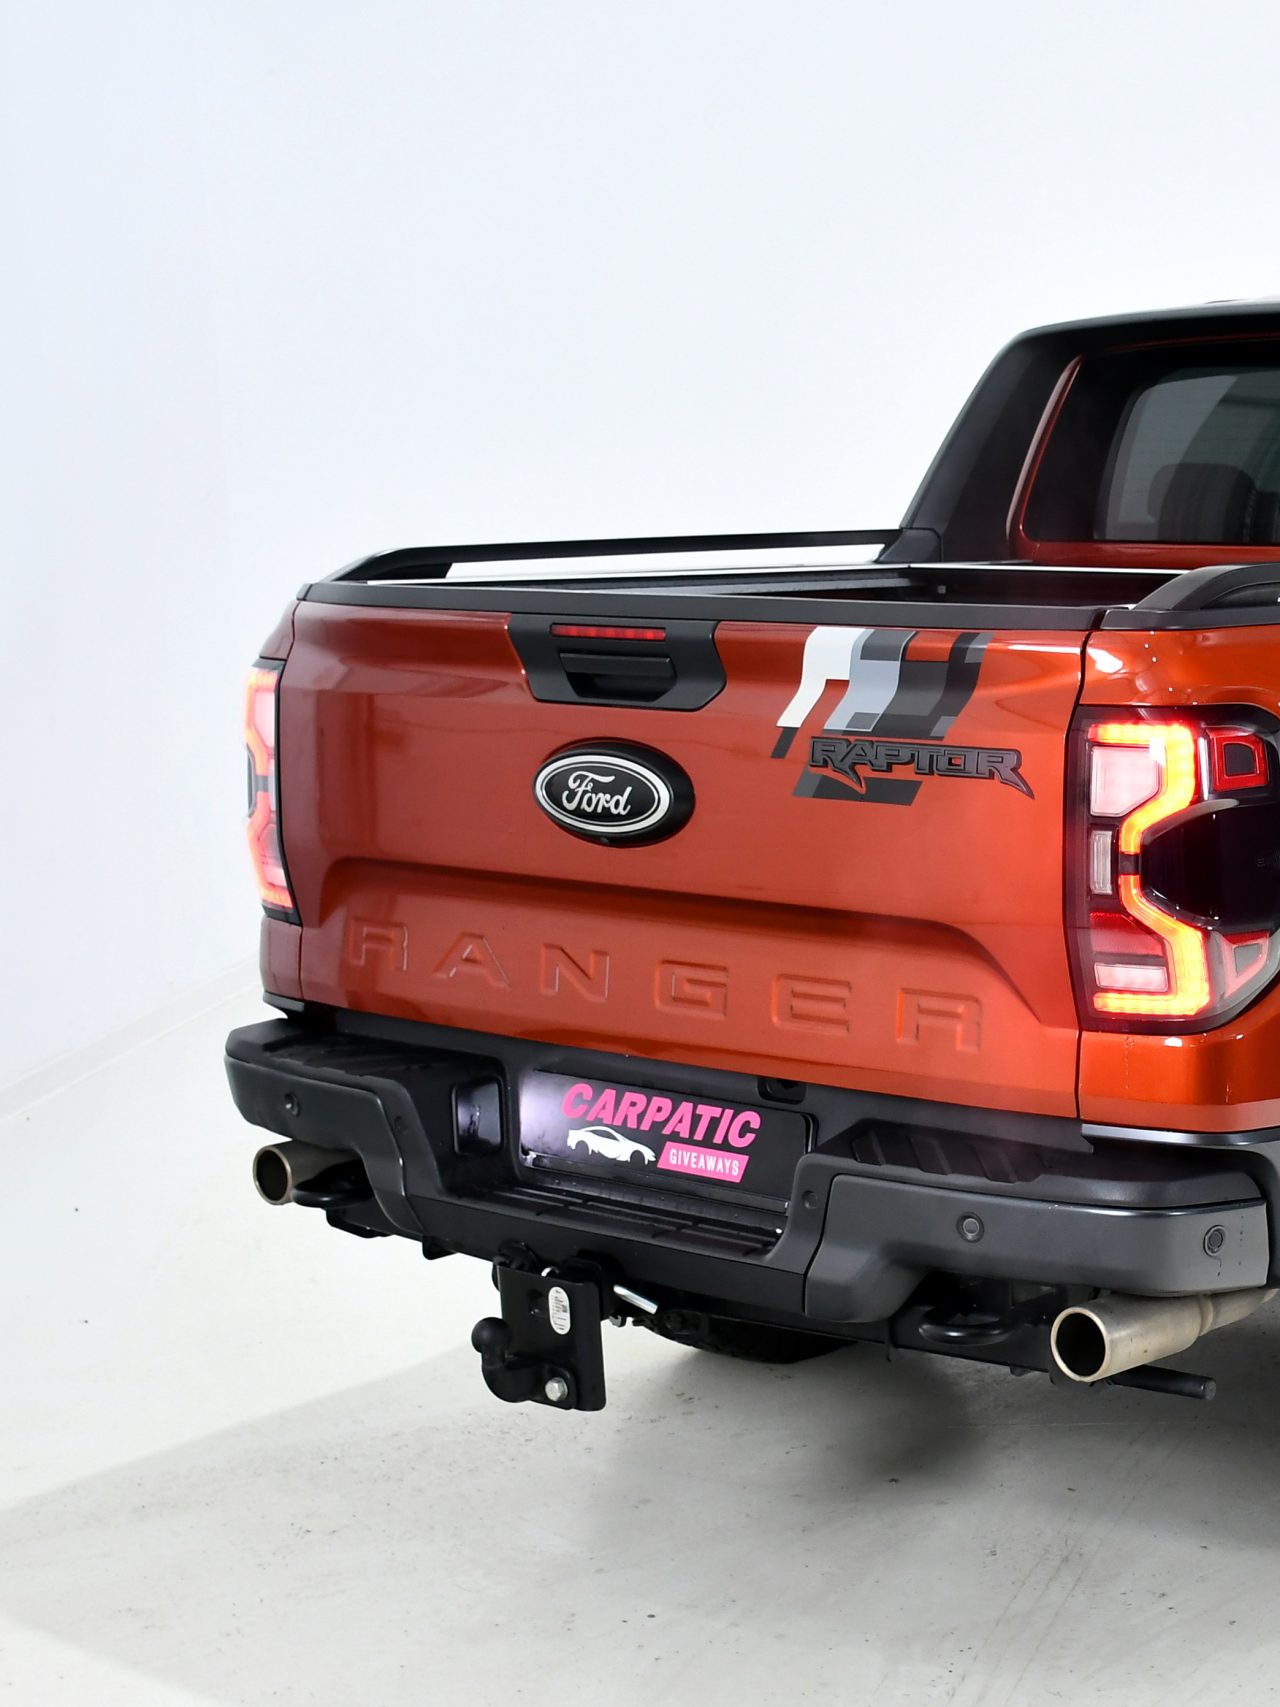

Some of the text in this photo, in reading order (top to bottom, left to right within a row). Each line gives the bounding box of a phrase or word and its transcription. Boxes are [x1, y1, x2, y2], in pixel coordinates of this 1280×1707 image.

[562, 771, 632, 815] Ford
[810, 736, 1036, 800] RAPTOR
[346, 917, 983, 1053] RANGER
[561, 1083, 761, 1148] CARPATIC
[669, 1148, 739, 1176] GIVEAWAYS
